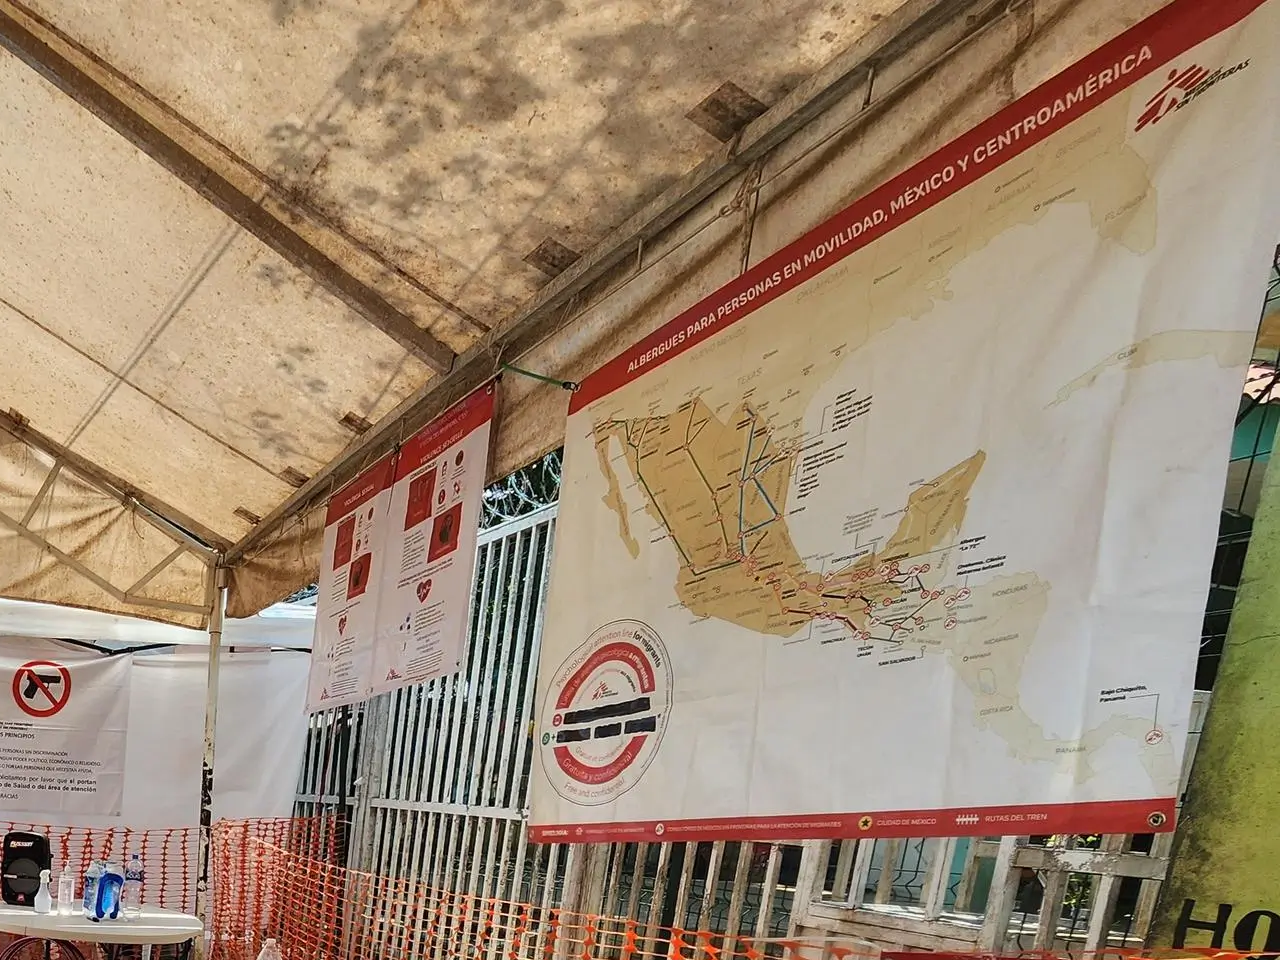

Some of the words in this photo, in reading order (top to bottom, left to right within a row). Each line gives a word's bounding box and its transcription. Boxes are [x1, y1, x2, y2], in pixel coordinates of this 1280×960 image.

[626, 331, 685, 374] ALBERGUES
[686, 312, 717, 339] PARA
[717, 271, 782, 321] PERSONAS
[783, 259, 802, 280] EN
[803, 209, 889, 267] MOVILIDAD,
[890, 164, 955, 216] MÉXICO
[956, 154, 969, 173] Y
[972, 45, 1152, 165] CENTROAMÉRICA
[633, 630, 643, 641] for
[640, 638, 661, 668] migrants
[71, 785, 97, 793] atención
[984, 814, 1010, 823] RUTAS
[1011, 813, 1025, 822] DEL
[1026, 812, 1048, 821] TREN
